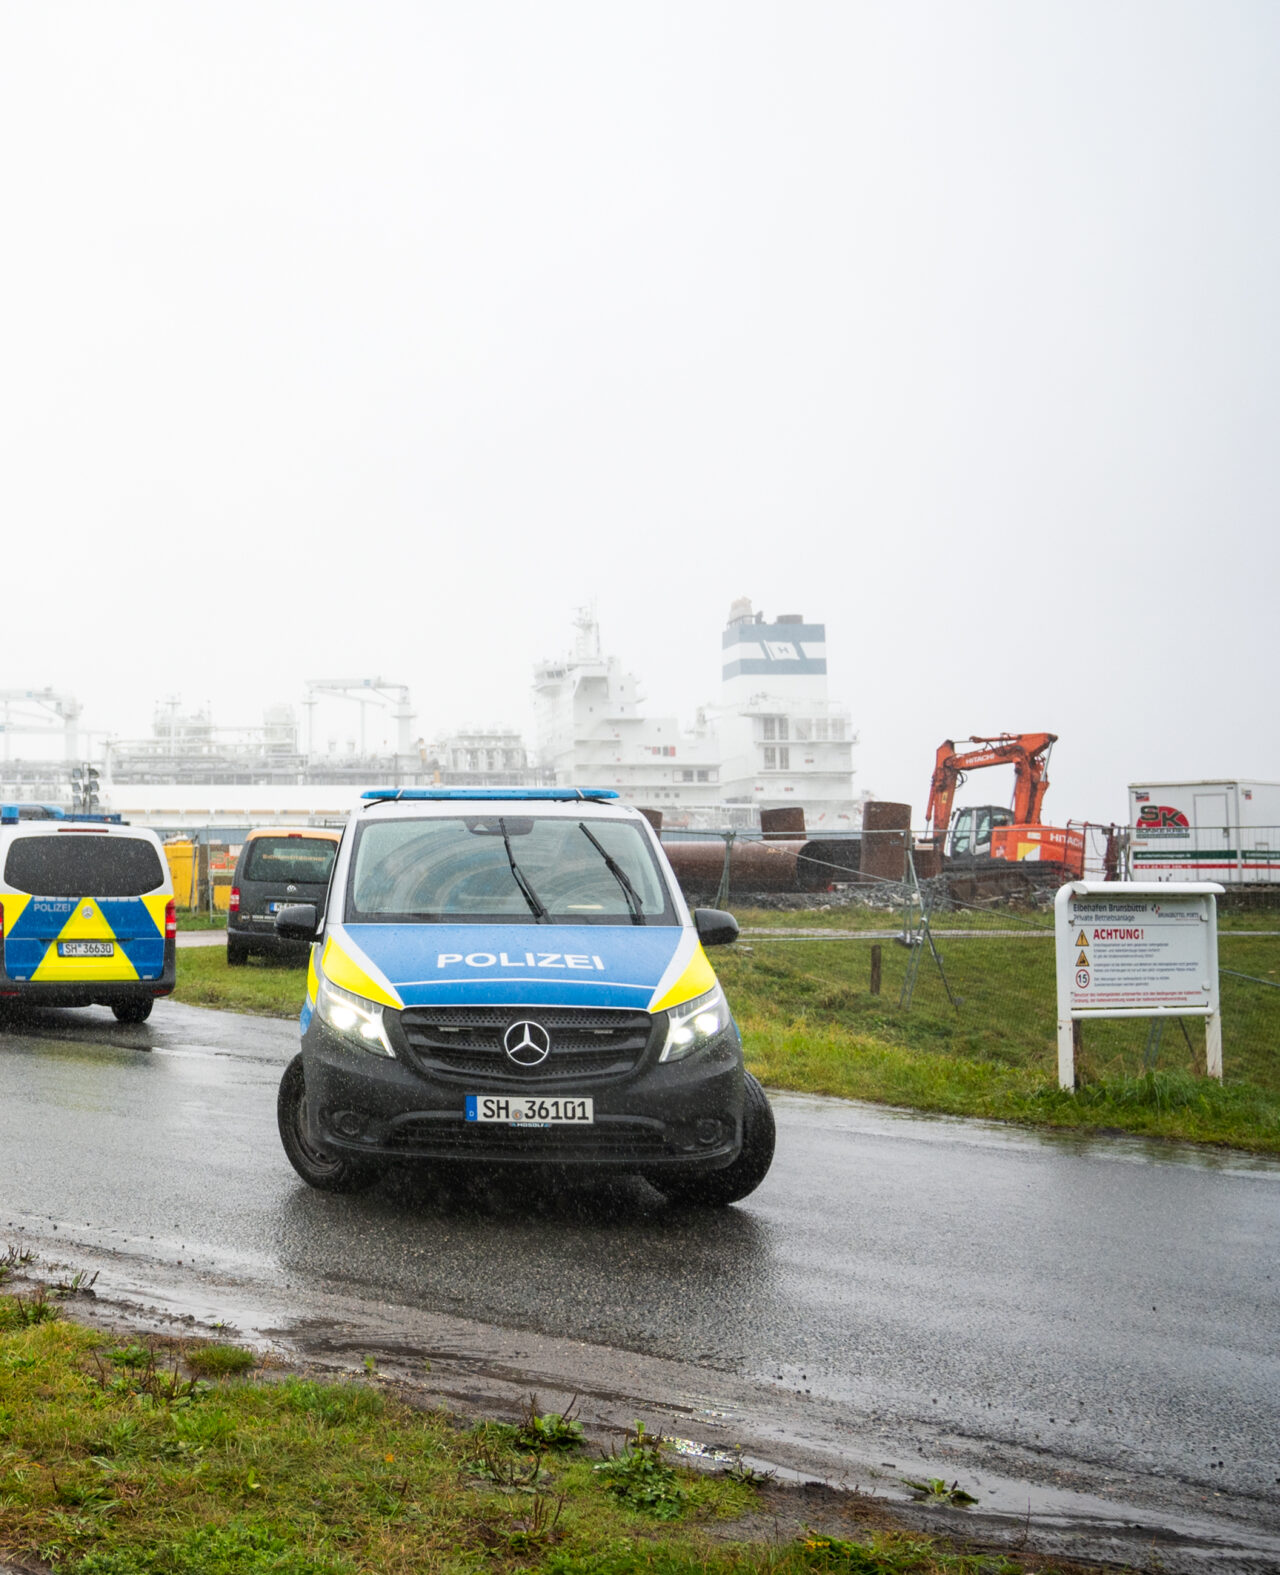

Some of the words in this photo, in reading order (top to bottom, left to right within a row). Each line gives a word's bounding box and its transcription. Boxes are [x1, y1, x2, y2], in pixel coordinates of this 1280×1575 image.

[965, 753, 995, 765] HITACHI
[33, 902, 71, 913] POLIZEI
[1073, 903, 1108, 912] Elbehafen
[1108, 903, 1147, 912] Brunsbüttel
[65, 943, 78, 954] SH
[83, 943, 112, 954] 36630
[437, 952, 605, 970] POLIZEI
[1078, 973, 1088, 983] 15
[482, 1099, 510, 1119] SH
[524, 1100, 589, 1120] 36101
